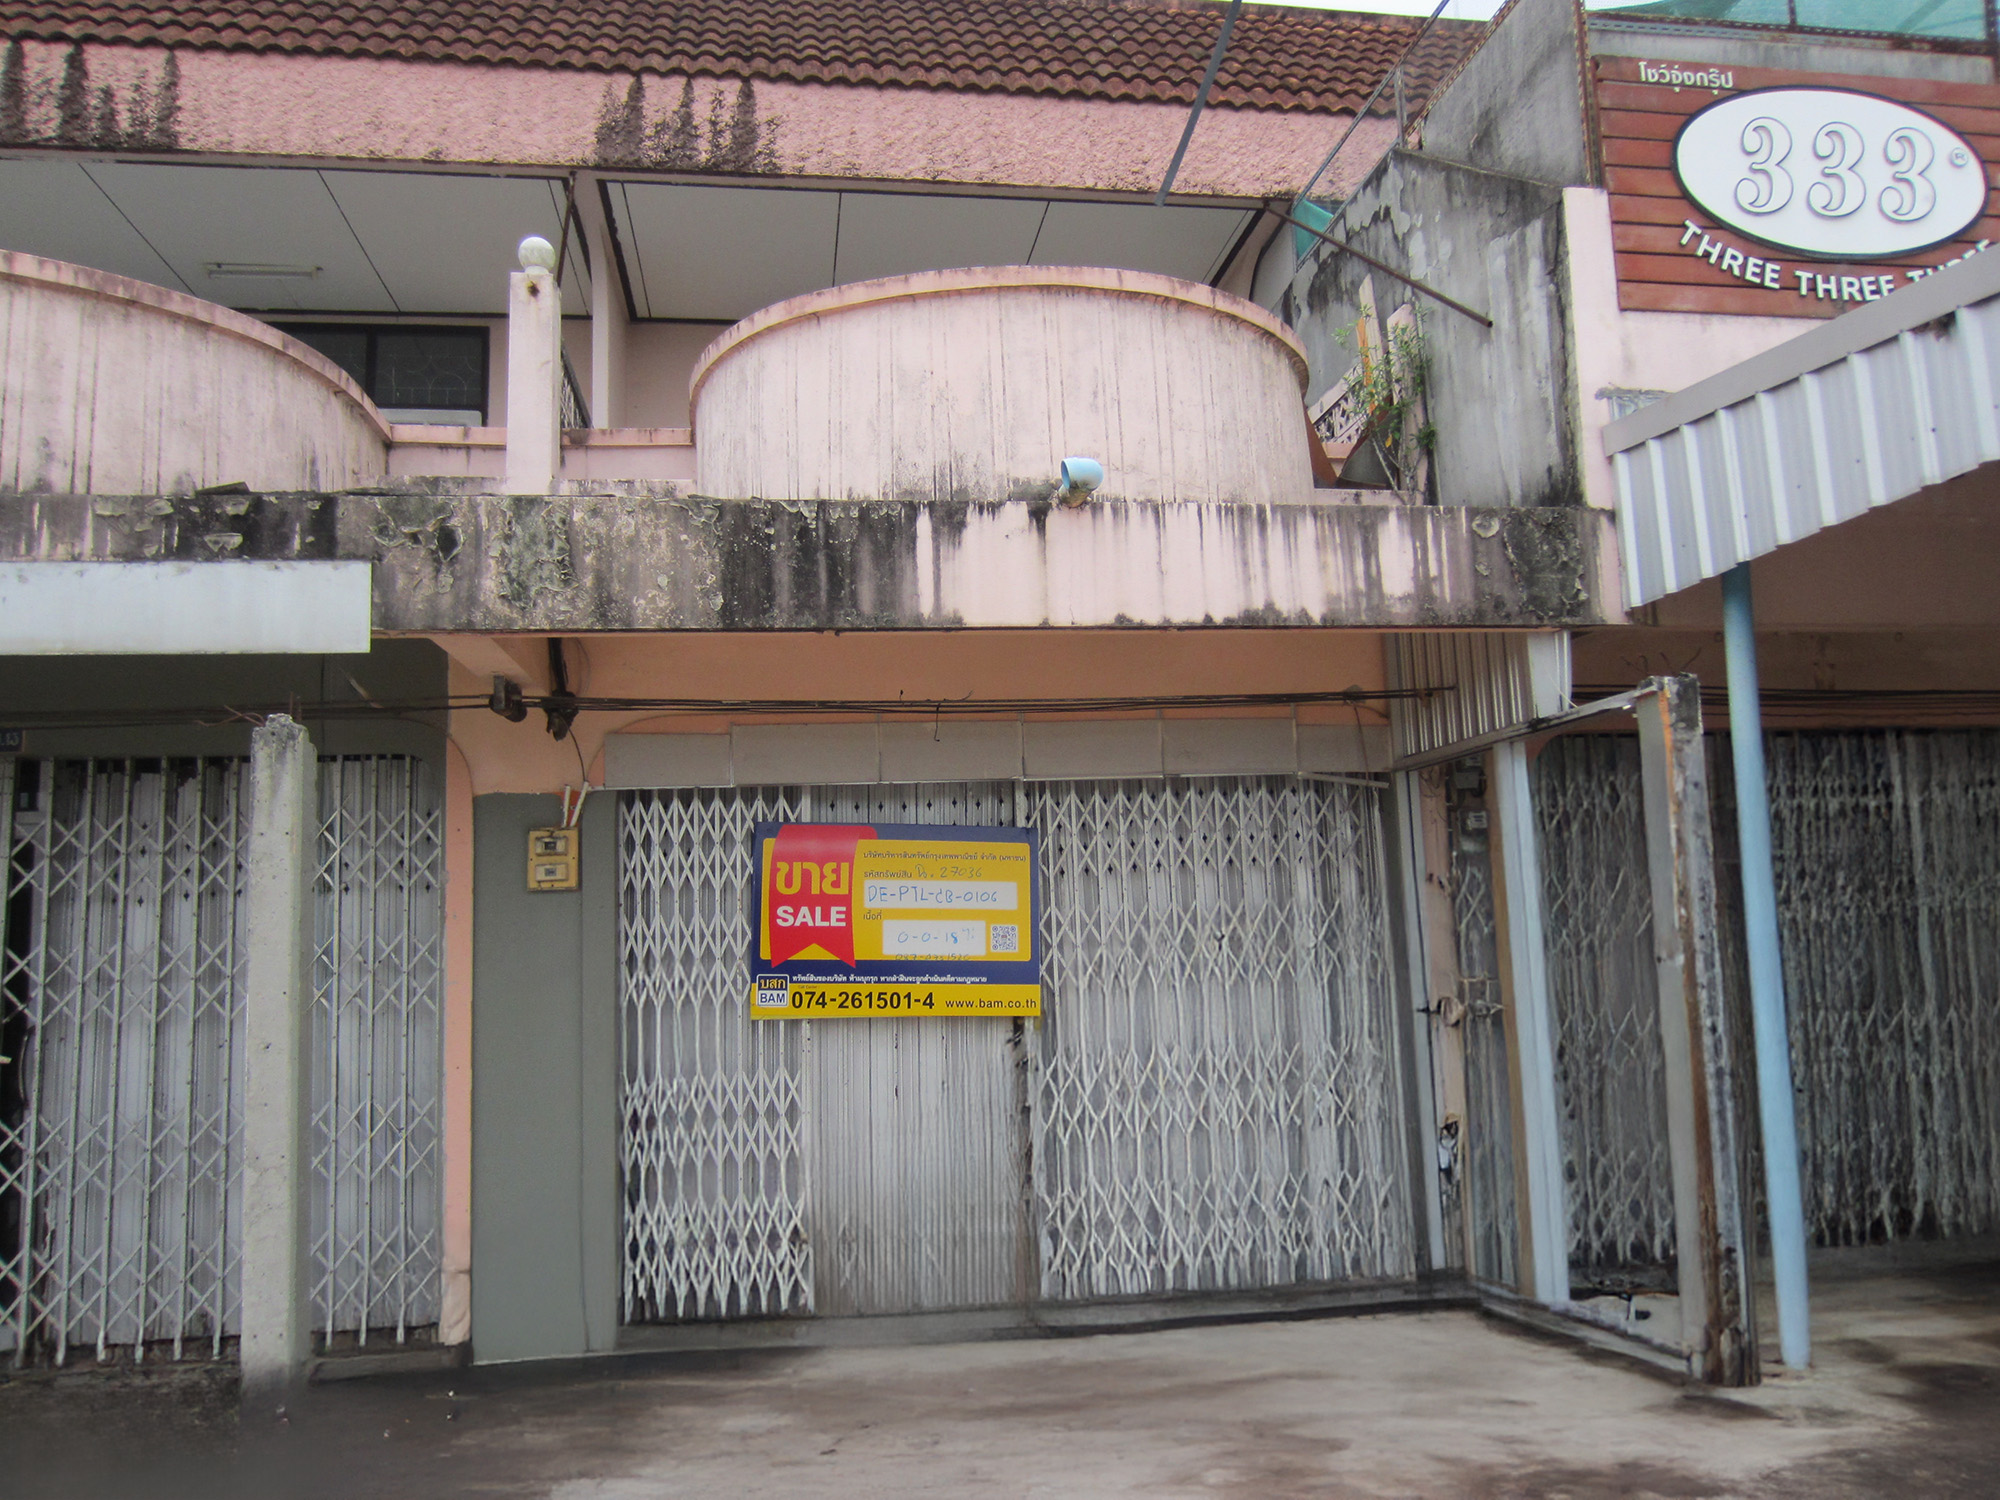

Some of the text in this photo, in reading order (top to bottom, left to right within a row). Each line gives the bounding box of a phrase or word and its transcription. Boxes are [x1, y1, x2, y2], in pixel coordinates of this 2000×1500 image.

[1734, 116, 1937, 223] 333
[1678, 219, 1782, 290] THREE
[776, 862, 850, 895] ขาย
[776, 905, 847, 927] SALE
[760, 978, 786, 989] บสก
[760, 993, 786, 1004] BAM
[791, 991, 1037, 1010] 074-261501-4 www.bam.co.th
